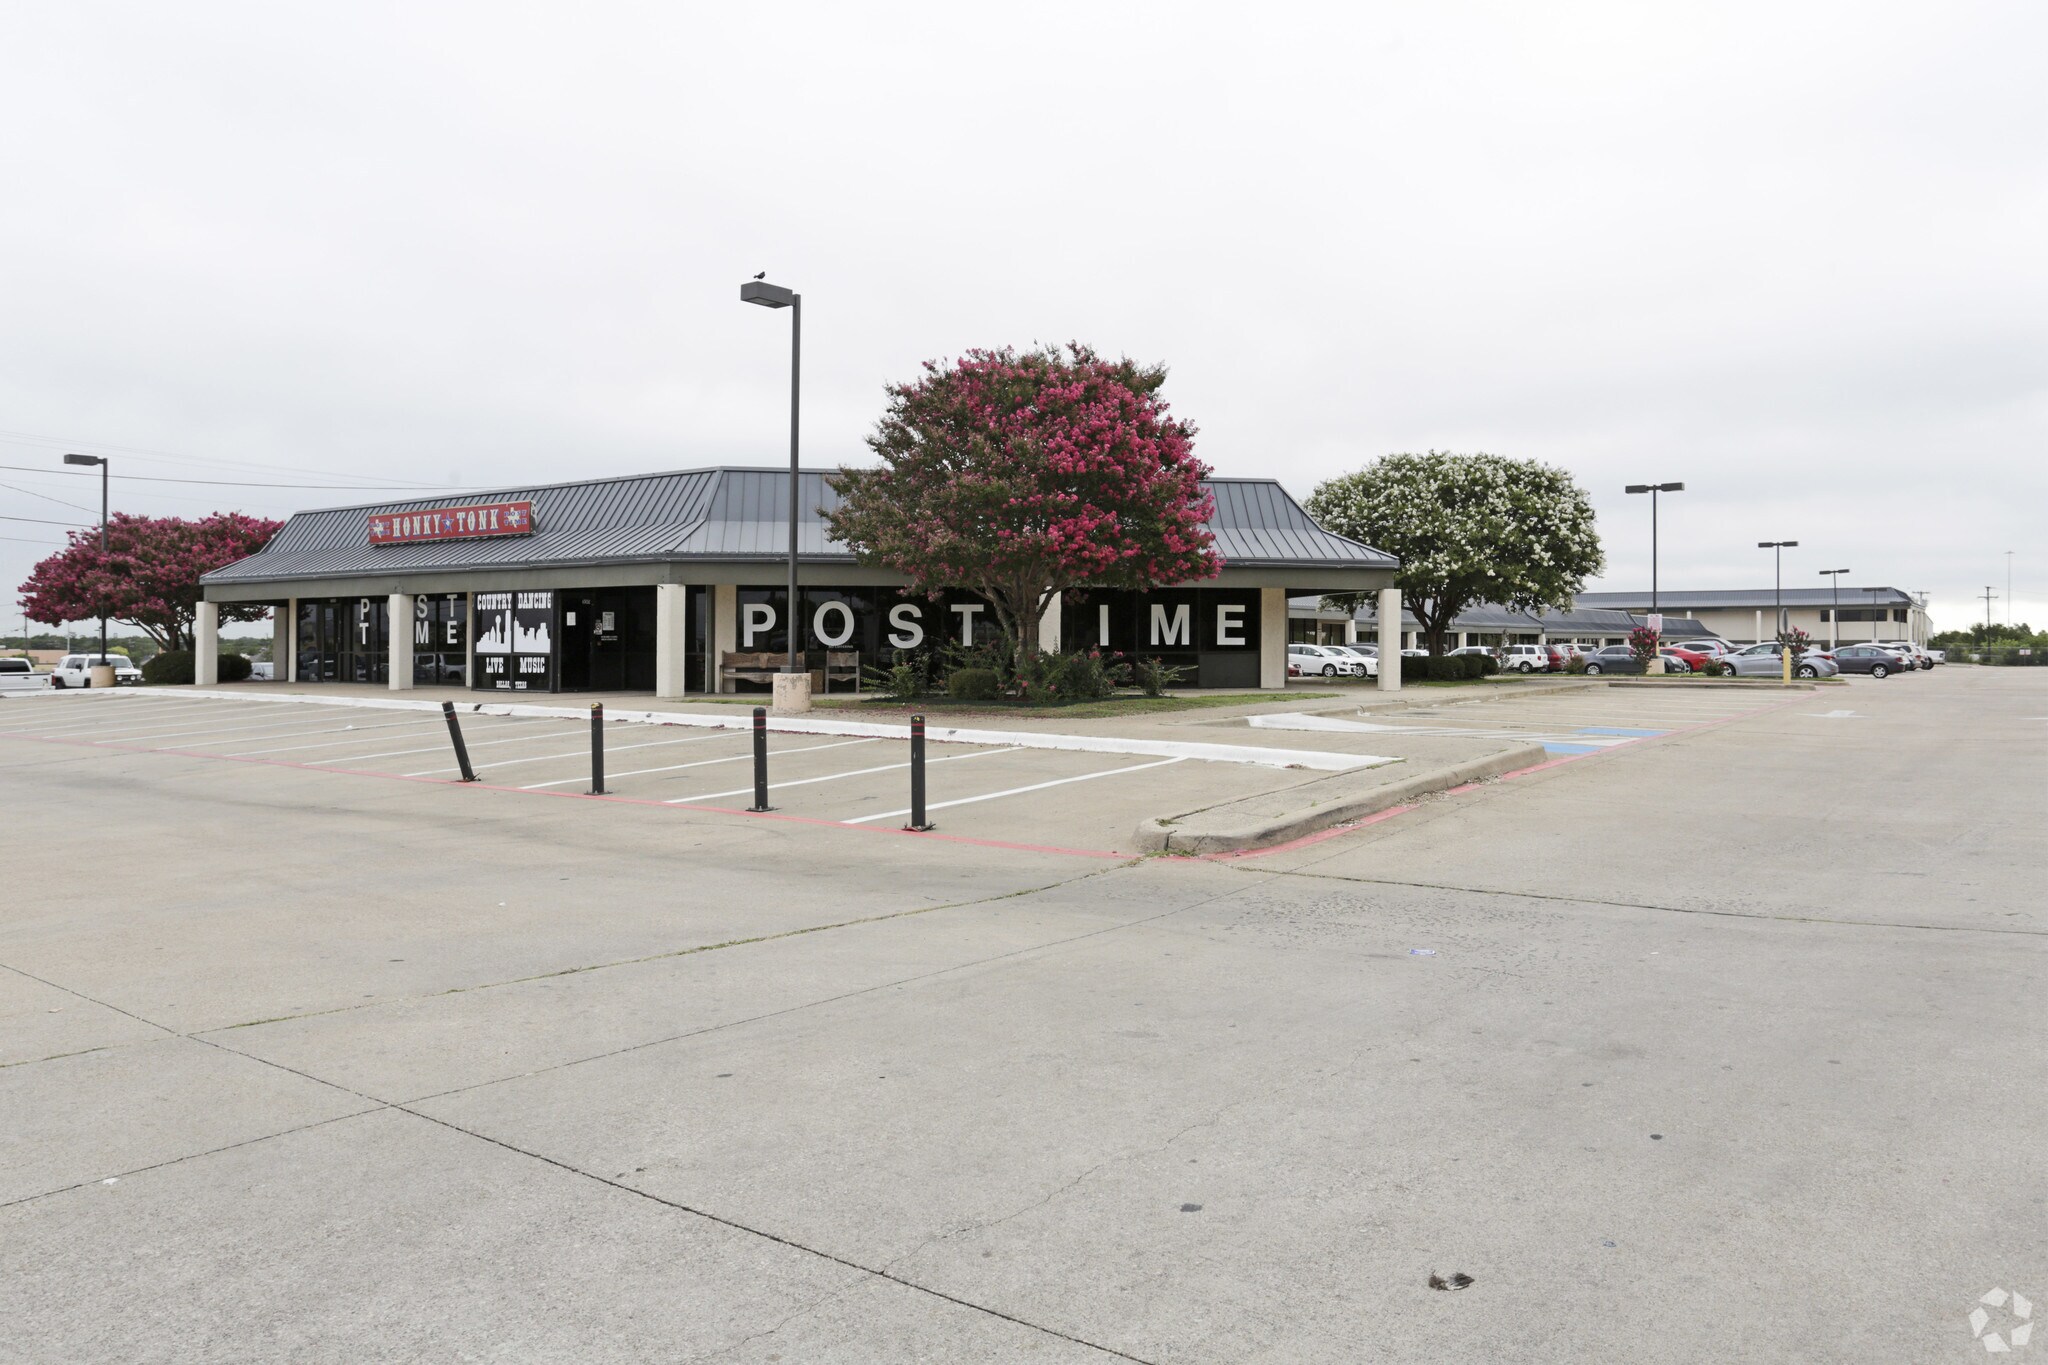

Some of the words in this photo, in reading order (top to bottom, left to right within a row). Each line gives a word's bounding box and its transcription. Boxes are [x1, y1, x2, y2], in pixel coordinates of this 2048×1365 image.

[392, 513, 441, 538] HONKY
[457, 509, 500, 532] TONK
[504, 518, 527, 526] TIME
[360, 594, 458, 621] PST
[477, 593, 512, 610] COUNTRY
[517, 592, 552, 609] DANCING
[358, 620, 458, 645] TME
[743, 601, 985, 649] POST
[486, 656, 504, 673] LIVE
[519, 656, 545, 673] MUSIC
